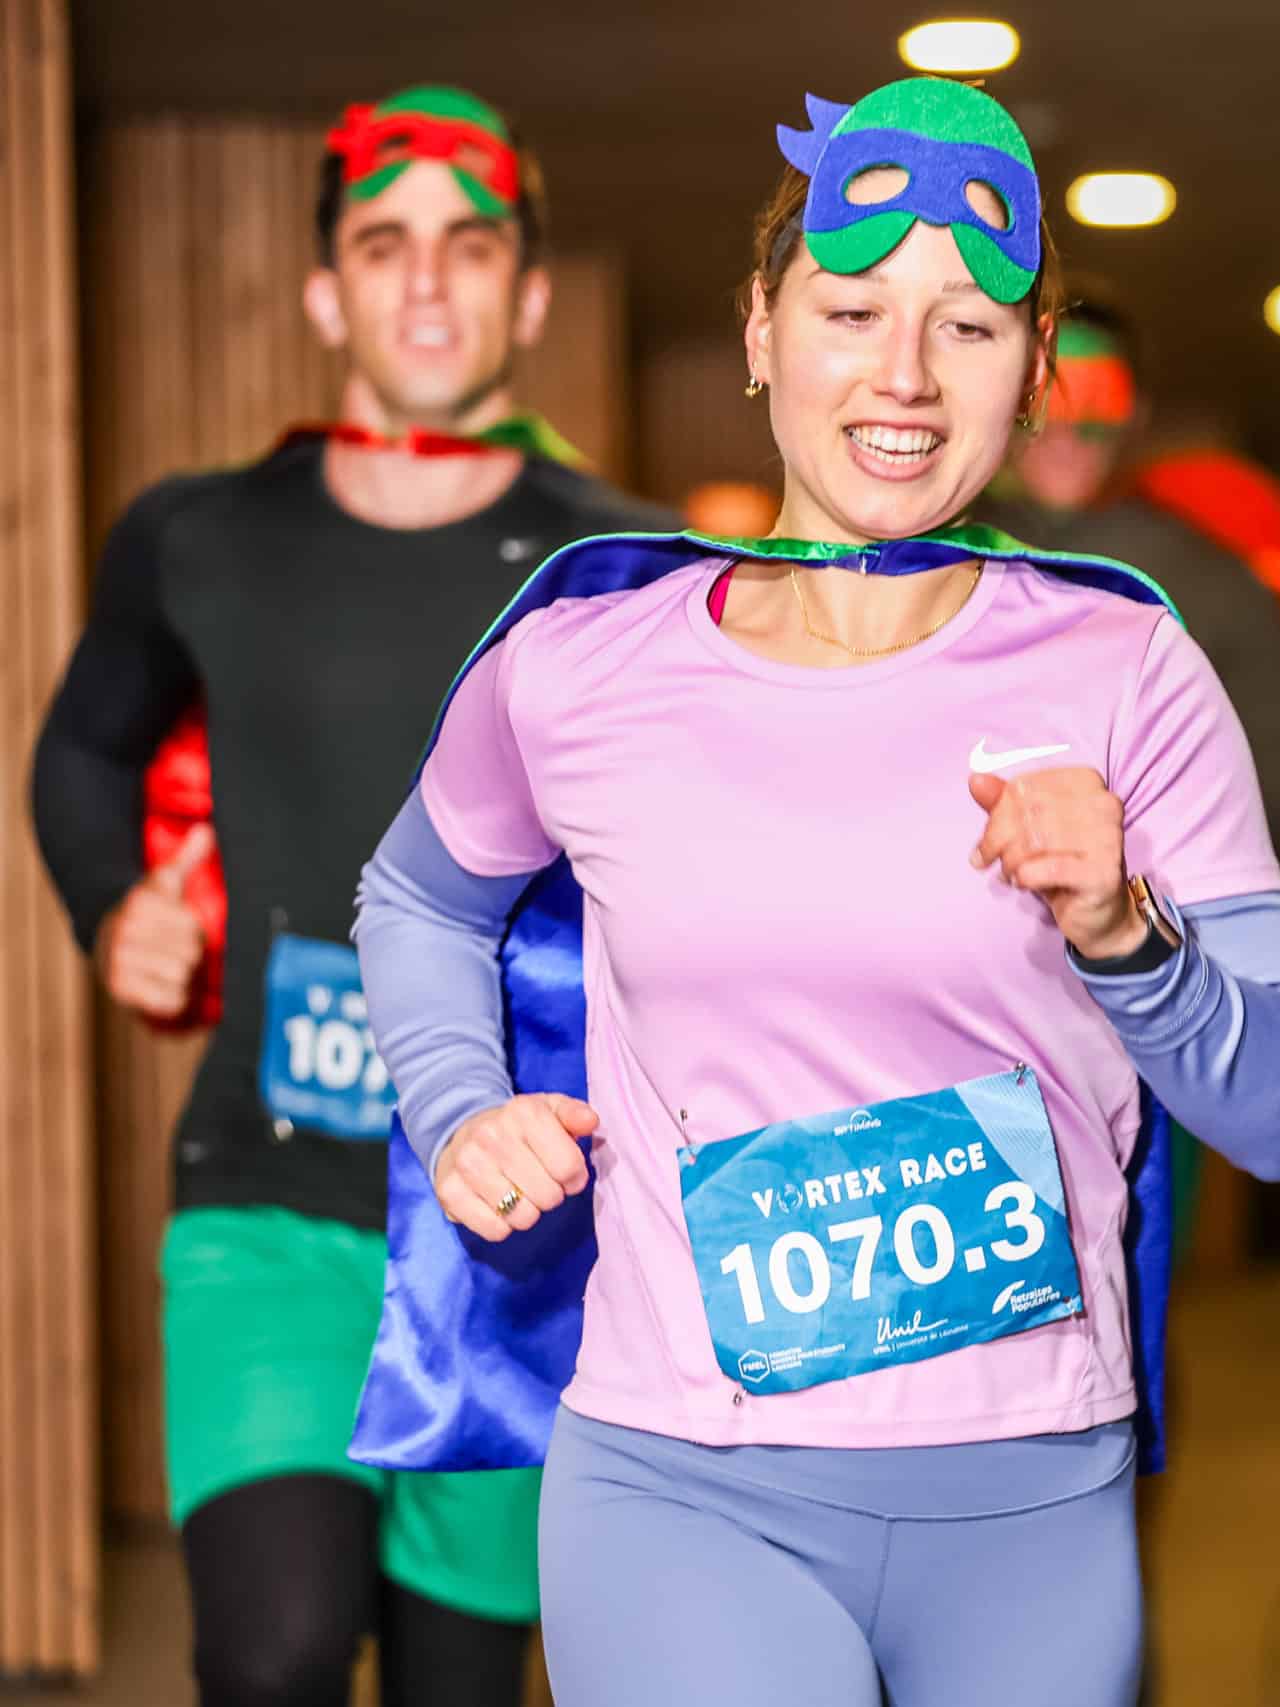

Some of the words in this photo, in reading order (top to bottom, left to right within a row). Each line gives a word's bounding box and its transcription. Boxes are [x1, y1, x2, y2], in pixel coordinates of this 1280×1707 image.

[752, 1165, 886, 1218] VORTEX
[900, 1142, 987, 1187] RACE
[720, 1181, 1046, 1324] 1070.3
[877, 1309, 948, 1345] Unil
